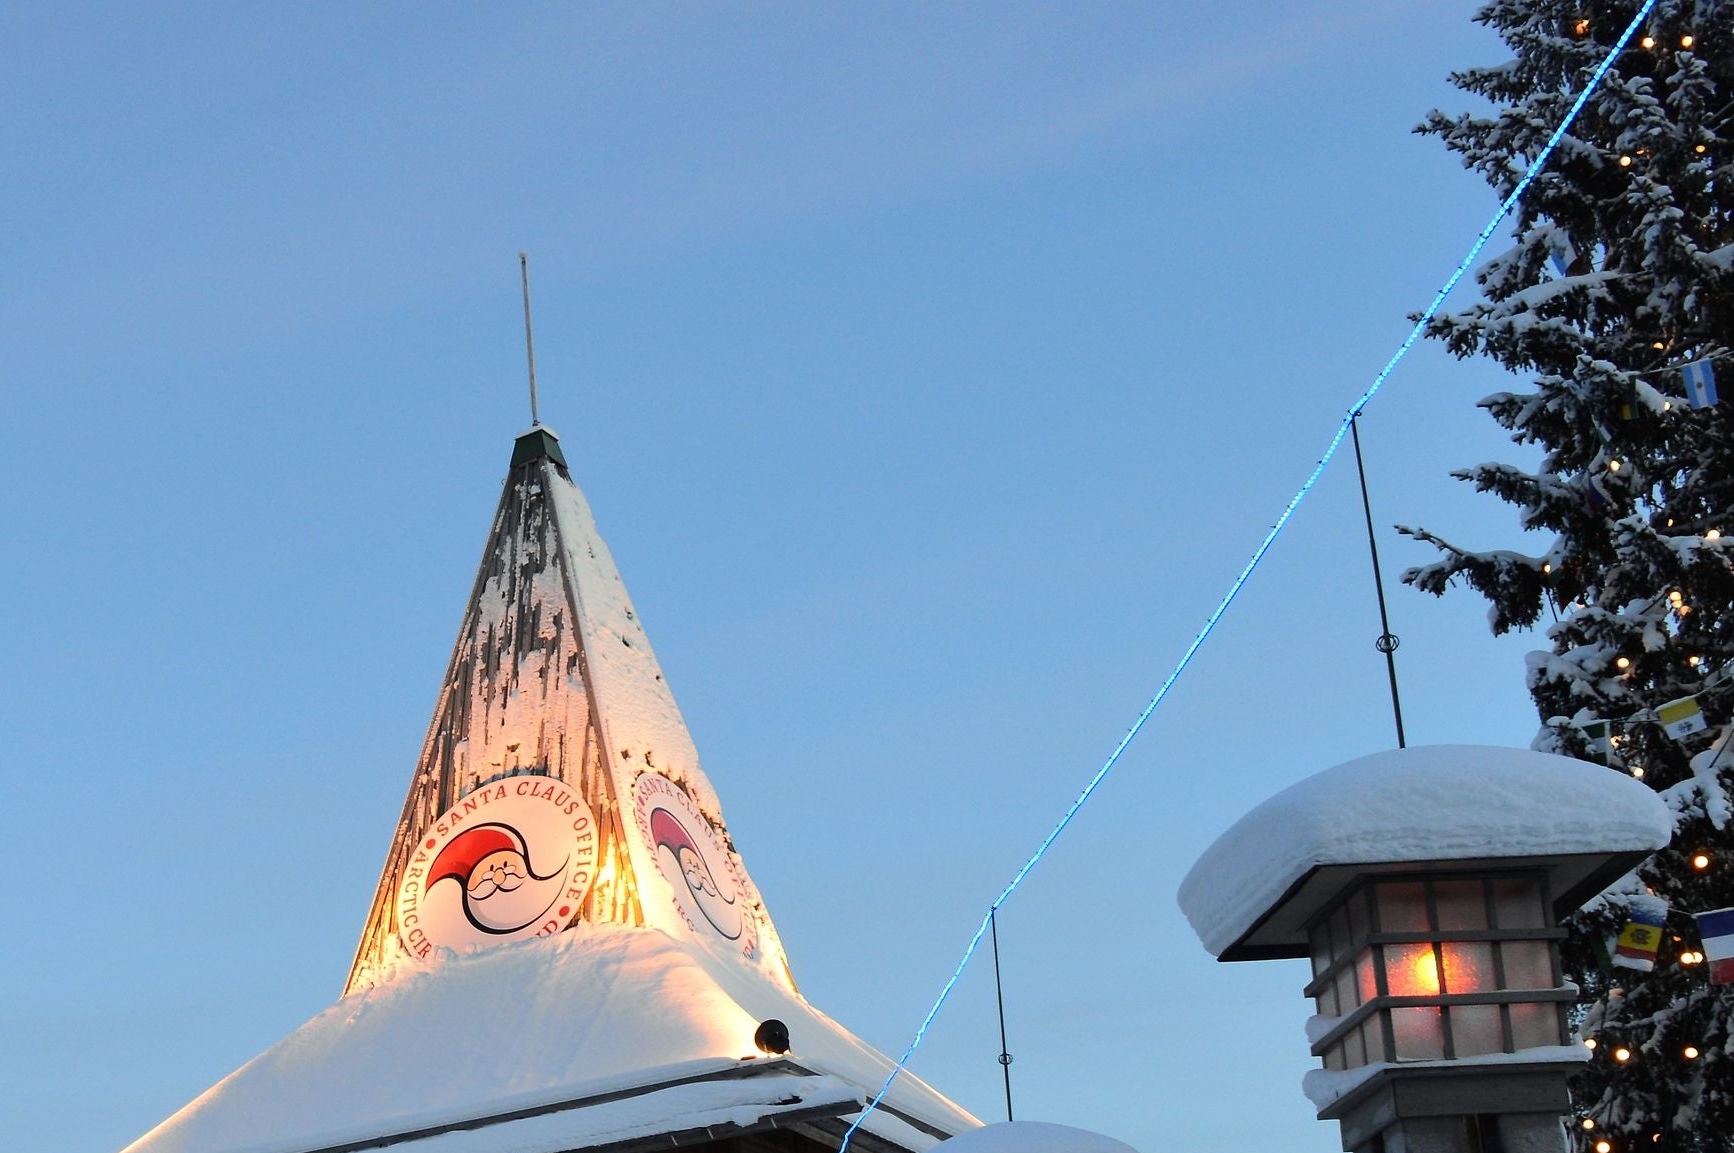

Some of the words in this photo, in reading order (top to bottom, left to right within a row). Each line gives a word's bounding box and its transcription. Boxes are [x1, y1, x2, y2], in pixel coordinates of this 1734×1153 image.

[641, 778, 674, 801] SANTA
[437, 784, 508, 838] SANTA
[516, 781, 581, 816] CLAUS
[566, 817, 593, 902] OFFICE
[402, 852, 429, 928] ARCTIC
[408, 928, 433, 959] CIR
